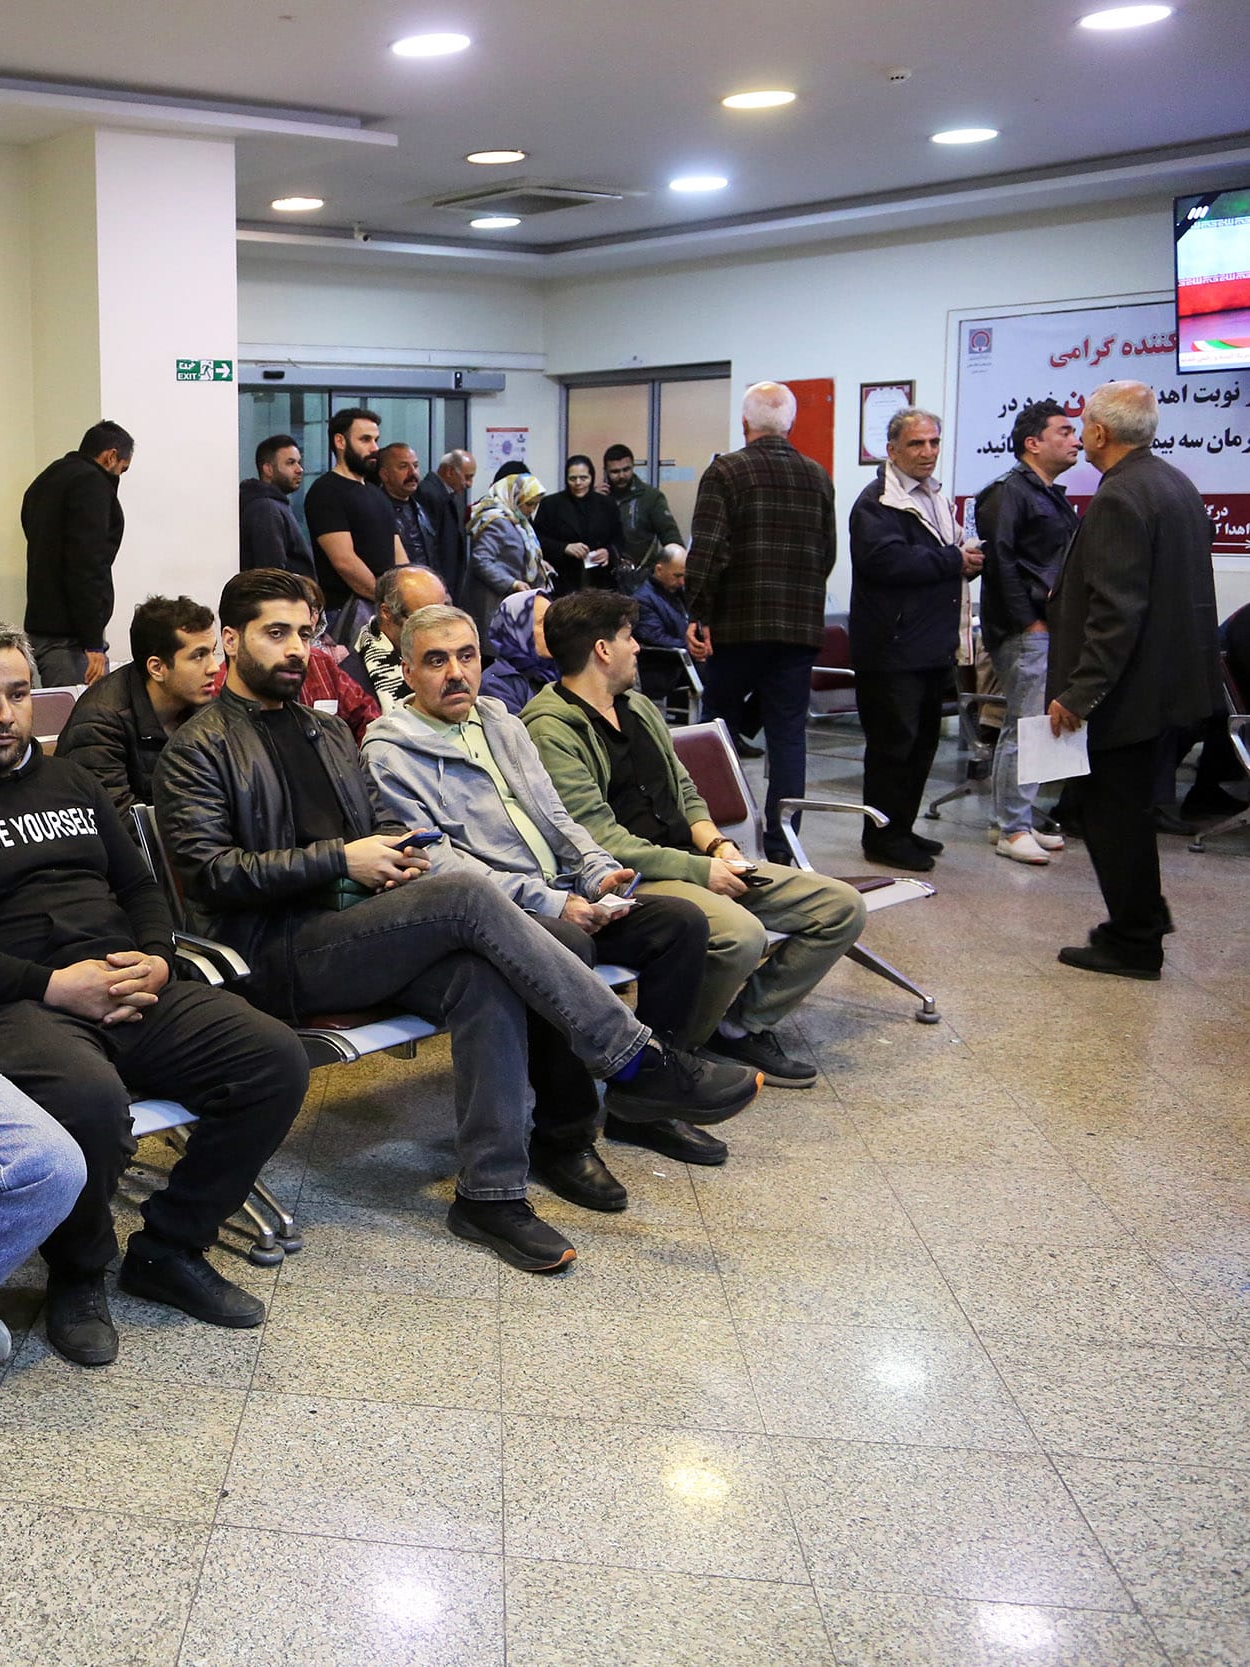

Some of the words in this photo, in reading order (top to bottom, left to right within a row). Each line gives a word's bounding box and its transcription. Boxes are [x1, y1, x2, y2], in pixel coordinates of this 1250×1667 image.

[177, 372, 197, 380] EXIT
[1193, 381, 1240, 408] نوبت
[997, 397, 1018, 418] در
[1151, 435, 1175, 455] بیم
[1178, 433, 1204, 449] سه
[9, 807, 98, 844] YOURSELF
